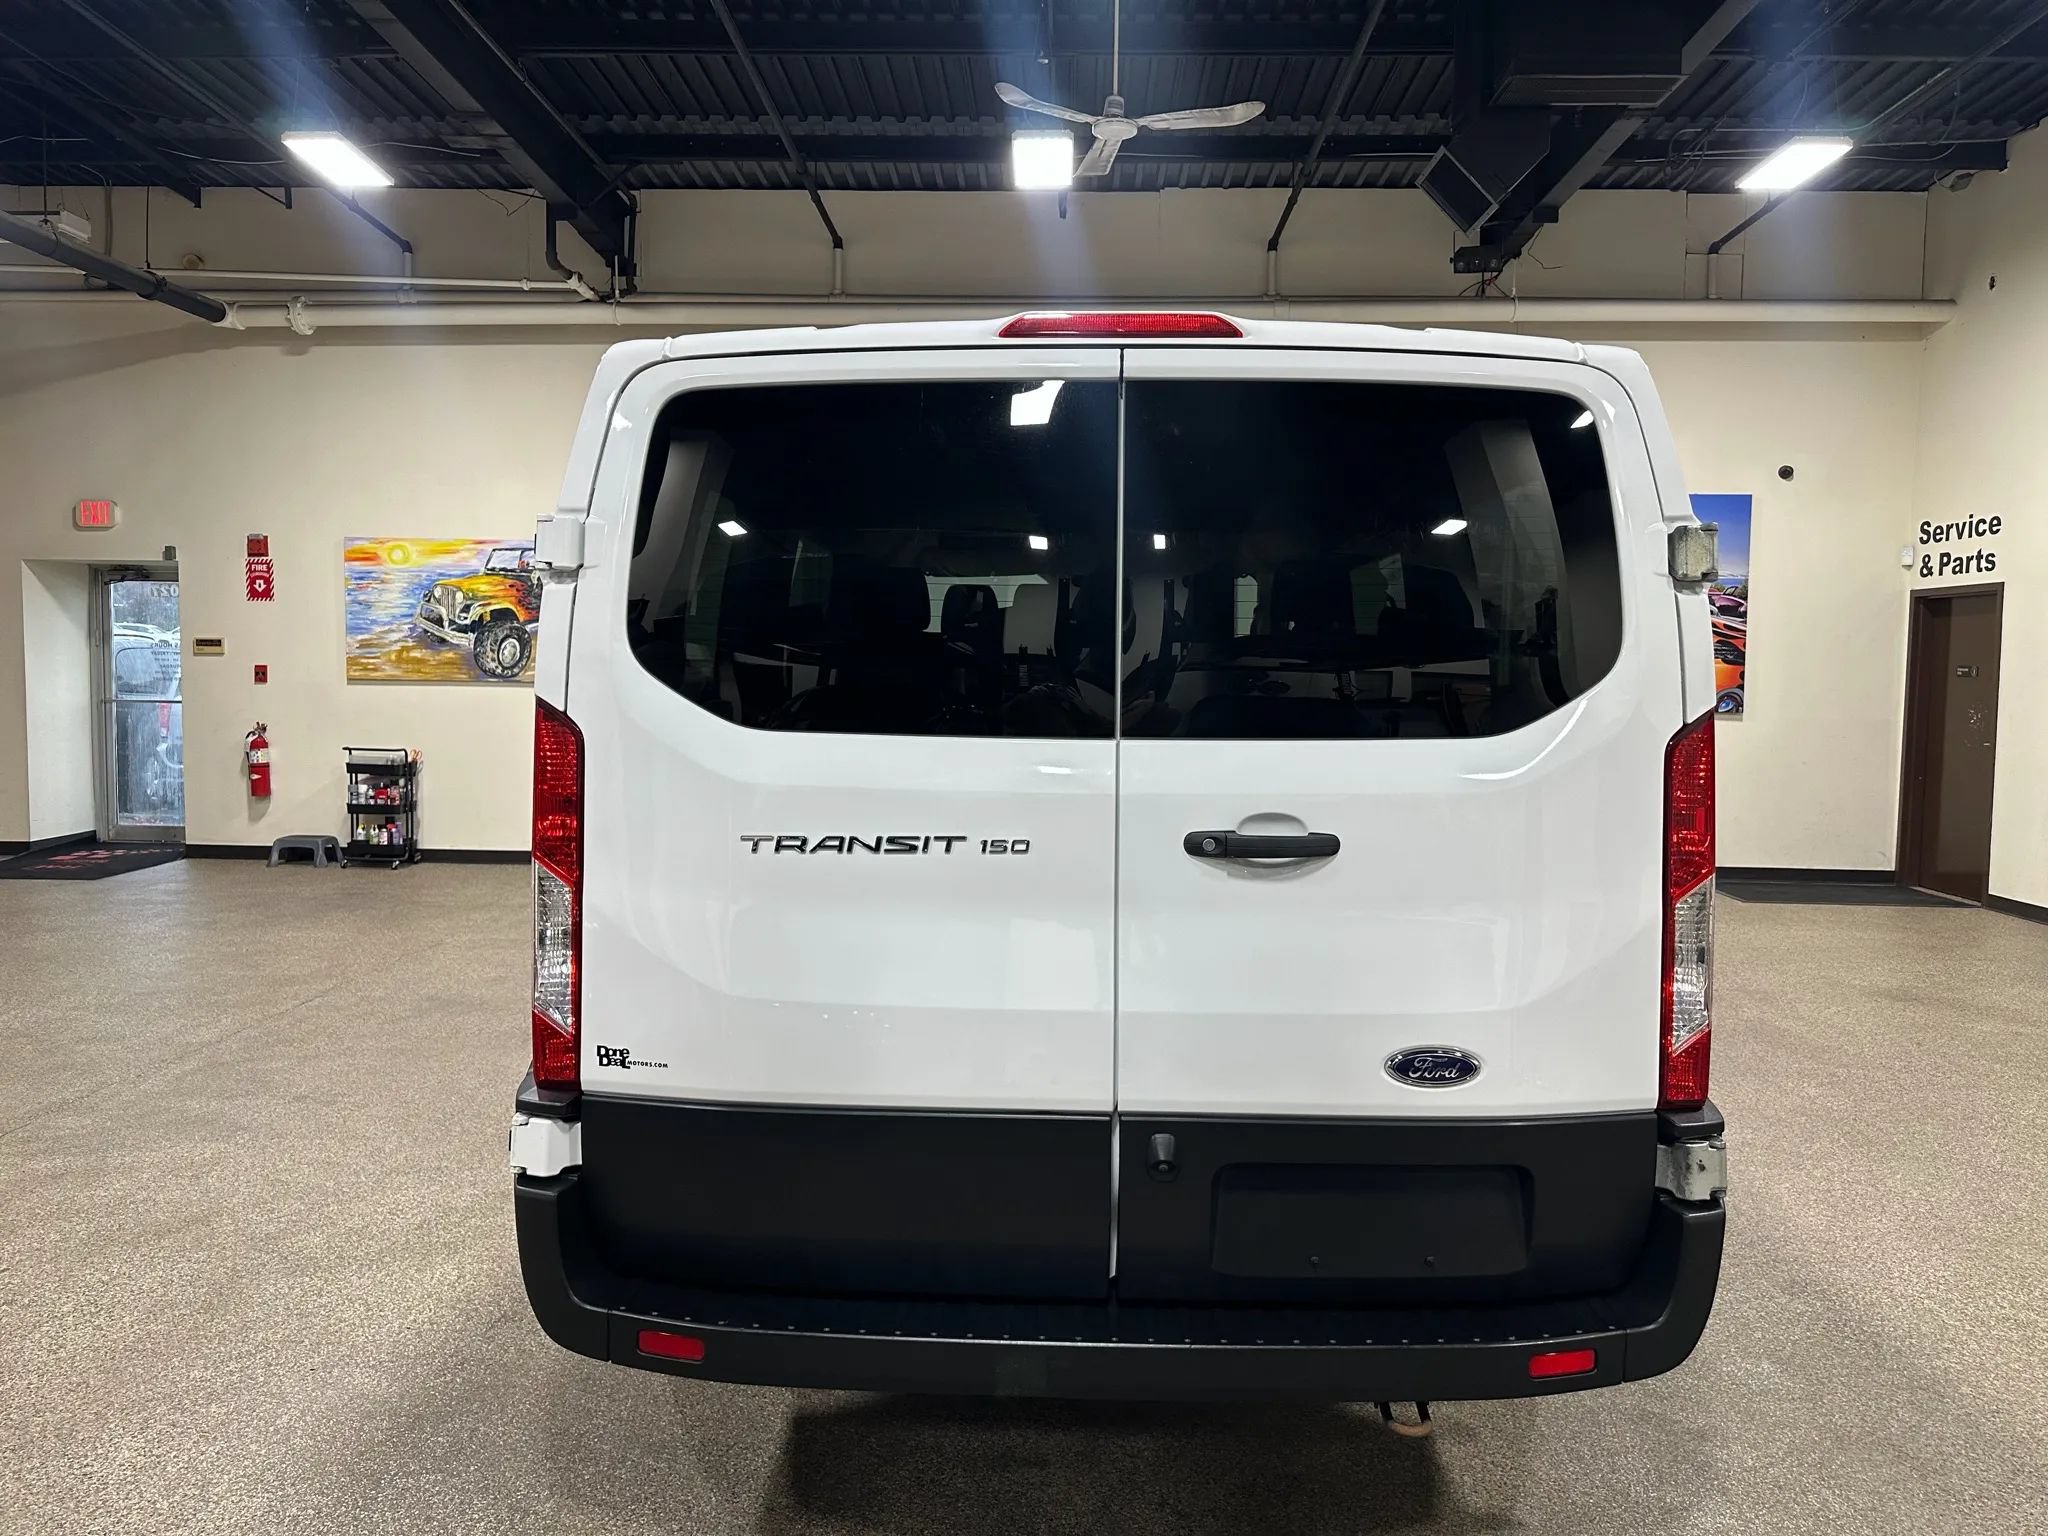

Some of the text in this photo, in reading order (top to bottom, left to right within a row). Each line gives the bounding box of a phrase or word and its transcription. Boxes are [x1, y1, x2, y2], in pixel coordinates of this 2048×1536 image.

[81, 500, 110, 526] EXIT
[1919, 513, 2002, 545] Service
[1919, 548, 1996, 578] & Parts
[740, 835, 1031, 855] TRANSIT 150
[597, 1045, 630, 1058] Done
[627, 1060, 668, 1068] MOTORS.COM
[1408, 1057, 1461, 1078] Ford
